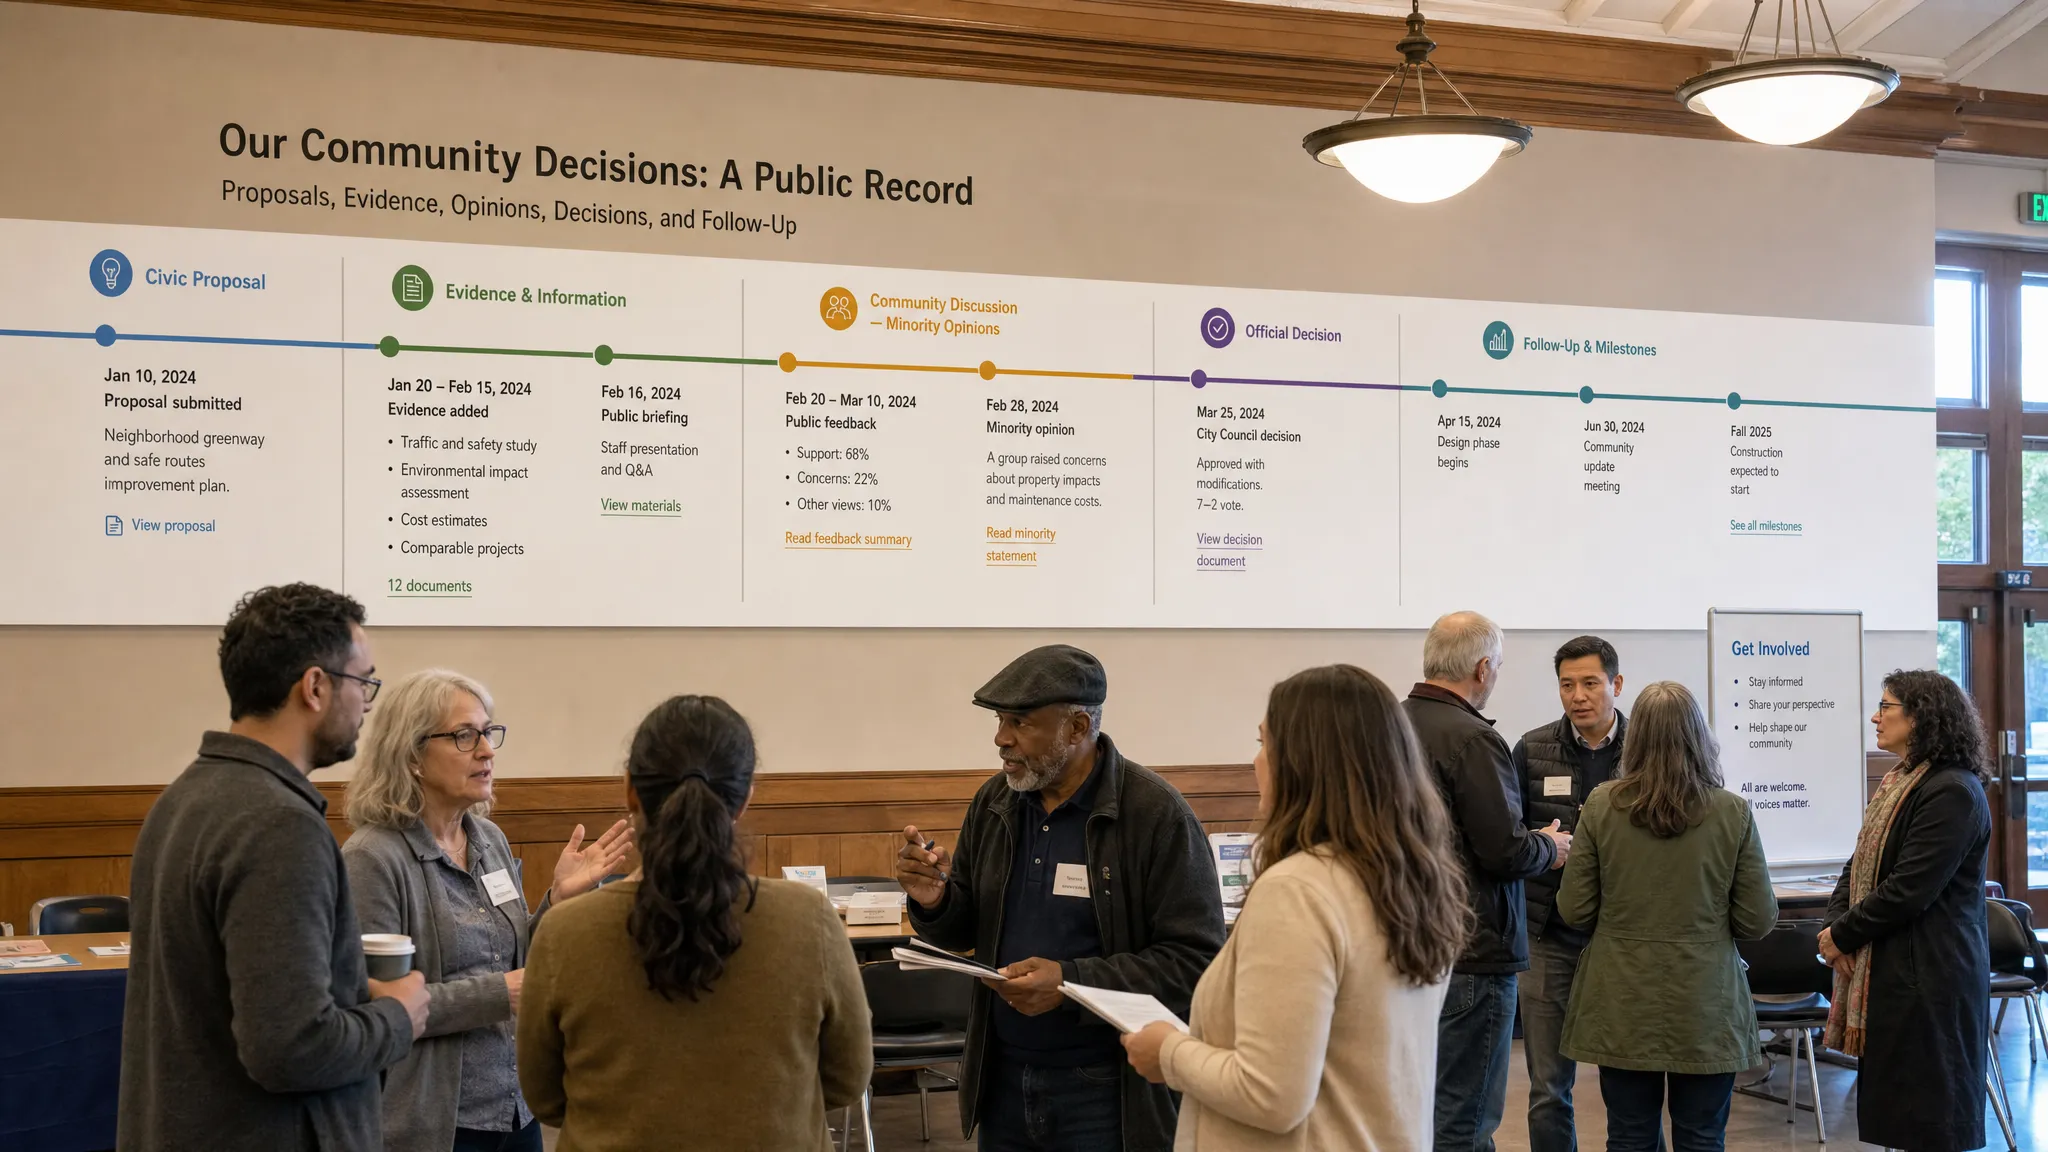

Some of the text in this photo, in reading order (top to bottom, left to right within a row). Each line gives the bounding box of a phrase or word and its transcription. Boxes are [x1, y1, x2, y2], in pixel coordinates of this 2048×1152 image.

[220, 123, 972, 205] Our Community Decisions: A Public Record
[223, 180, 796, 239] Proposals, Evidence, Opinions, Decisions, and Follow-Up
[146, 268, 265, 292] Civic Proposal
[447, 284, 626, 307] Evidence & Information
[871, 293, 1017, 314] Community Discussion
[887, 316, 1000, 336] Minority Opinions
[1246, 324, 1341, 342] Official Decision
[1524, 337, 1656, 356] Follow-Up & Milestones
[388, 378, 531, 396] Jan 20 Feb 15, 2024
[105, 393, 241, 411] Proposal submitted
[786, 392, 916, 409] Feb 20 Mar 10, 2024
[987, 399, 1058, 414] Feb 28, 2024
[602, 409, 688, 427] Public briefing
[1198, 406, 1264, 420] Mar 25, 2024
[786, 415, 876, 429] Public feedback
[987, 421, 1074, 437] Minority opinion
[1438, 415, 1501, 429] Apr 15, 2024
[1584, 420, 1644, 434] Jun 30, 2024
[1197, 428, 1301, 442] City Council decision
[1731, 425, 1771, 437] Fall 2025
[105, 428, 264, 449] Neighborhood greenway
[401, 435, 537, 455] Traffic and safety study
[1438, 436, 1500, 450] Design phase
[601, 441, 698, 457] Staff presentation
[798, 446, 869, 462] Support: 68%
[1584, 440, 1634, 455] Community
[1731, 446, 1782, 457] Construction
[105, 453, 205, 467] and safe routes
[987, 451, 1106, 467] A group raised concerns
[1197, 457, 1264, 471] Approved with
[1438, 456, 1468, 470] begins
[402, 463, 528, 481] Environmental impact
[601, 463, 653, 476] and Q&A
[1584, 461, 1615, 474] update
[1731, 466, 1779, 478] expected to
[798, 471, 878, 485] Concerns: 22%
[987, 472, 1100, 488] about property impacts
[1197, 478, 1262, 490] modifications.
[104, 477, 230, 495] improvement plan.
[1584, 482, 1620, 494] meeting
[1731, 485, 1749, 494] start
[401, 488, 469, 499] assessment
[986, 493, 1101, 506] and maintenance costs.
[601, 498, 681, 511] View materials
[798, 498, 891, 511] Other views: 10%
[1220, 501, 1243, 510] vote.
[132, 519, 215, 534] View proposal
[401, 513, 487, 527] Cost estimates
[1731, 520, 1802, 531] See all milestones
[786, 532, 912, 548] Read feedback summary
[987, 527, 1056, 542] Read minority
[1197, 533, 1262, 545] View decision
[401, 541, 524, 558] Comparable projects
[987, 551, 1036, 561] statement
[1197, 555, 1245, 566] document
[388, 579, 472, 592] 12 documents
[1732, 641, 1809, 655] Get Involved
[1749, 676, 1803, 689] Stay informed
[1749, 699, 1834, 712] Share your perspective
[1750, 723, 1768, 735] Help
[1770, 722, 1792, 733] shape
[1749, 739, 1792, 750] community
[1741, 783, 1752, 792] All
[1770, 782, 1807, 791] welcome.
[1755, 799, 1810, 809] voices matter.
